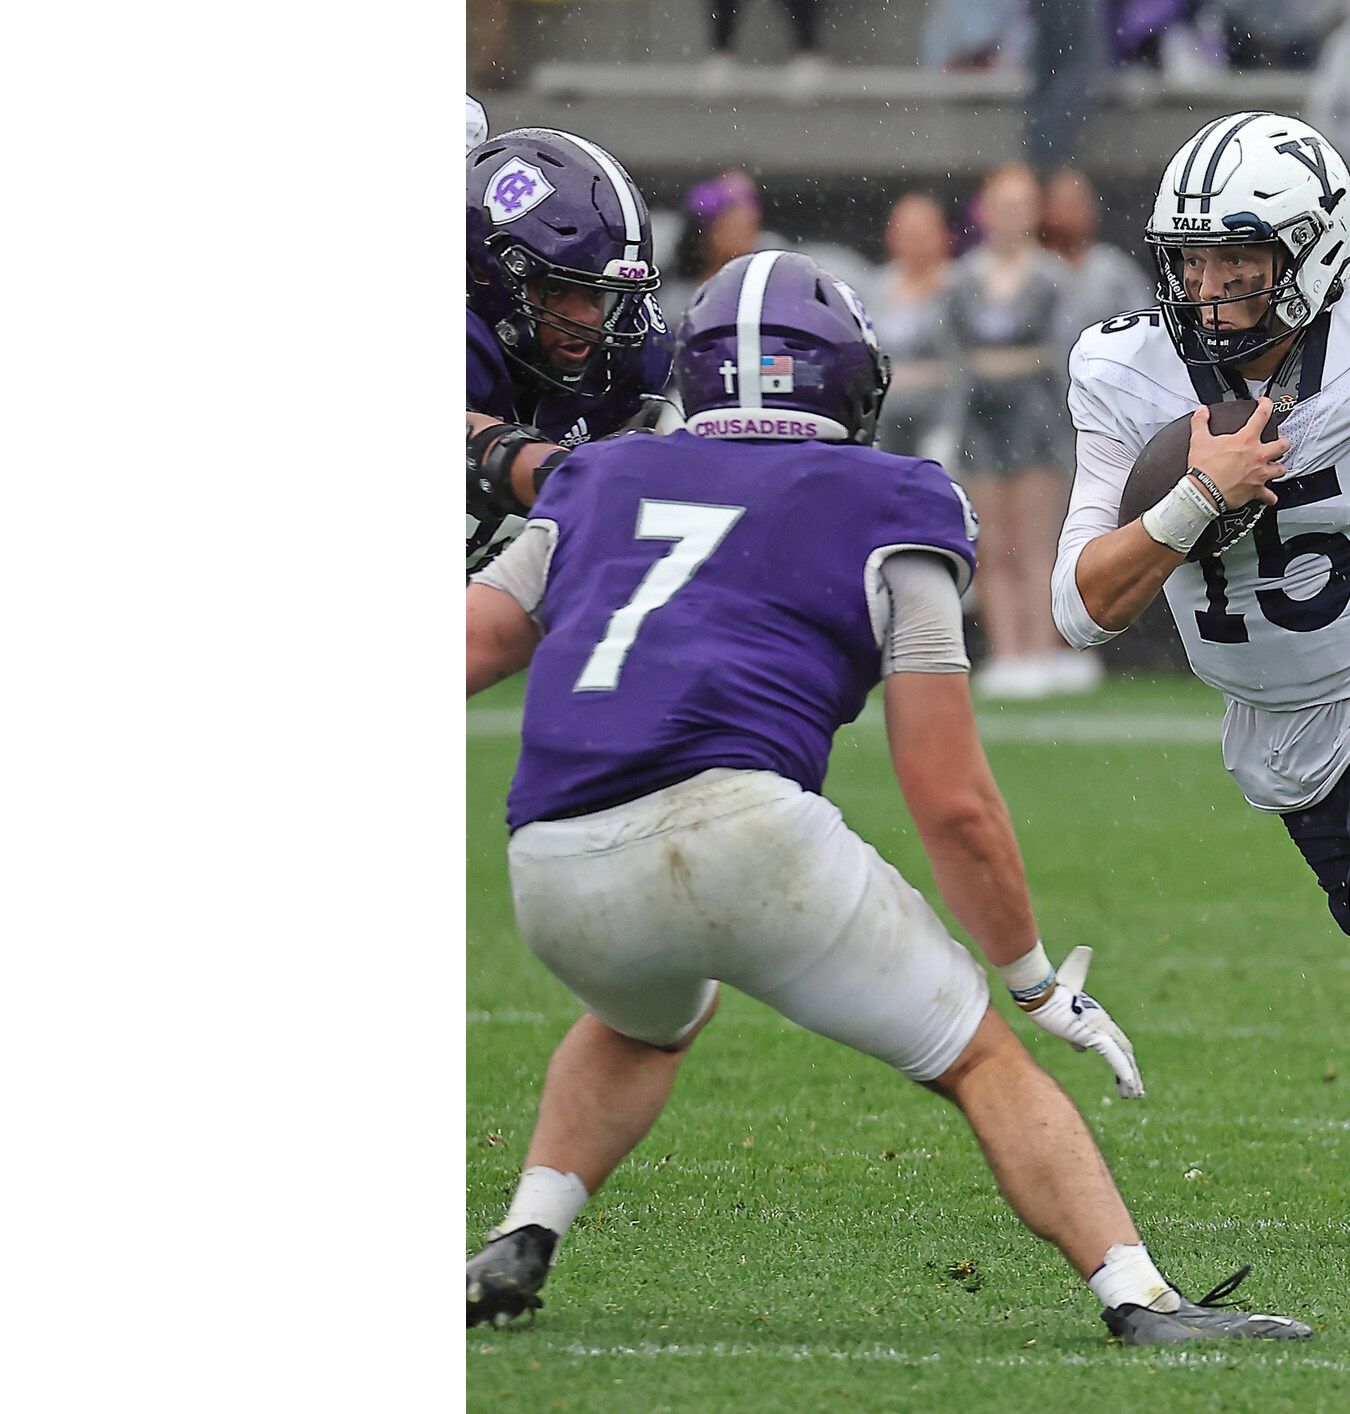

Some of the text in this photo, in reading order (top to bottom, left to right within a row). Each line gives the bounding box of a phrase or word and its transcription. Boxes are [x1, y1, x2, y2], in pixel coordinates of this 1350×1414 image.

[1172, 217, 1212, 231] YALE
[695, 419, 817, 436] CRUSADERS
[573, 498, 746, 692] 7
